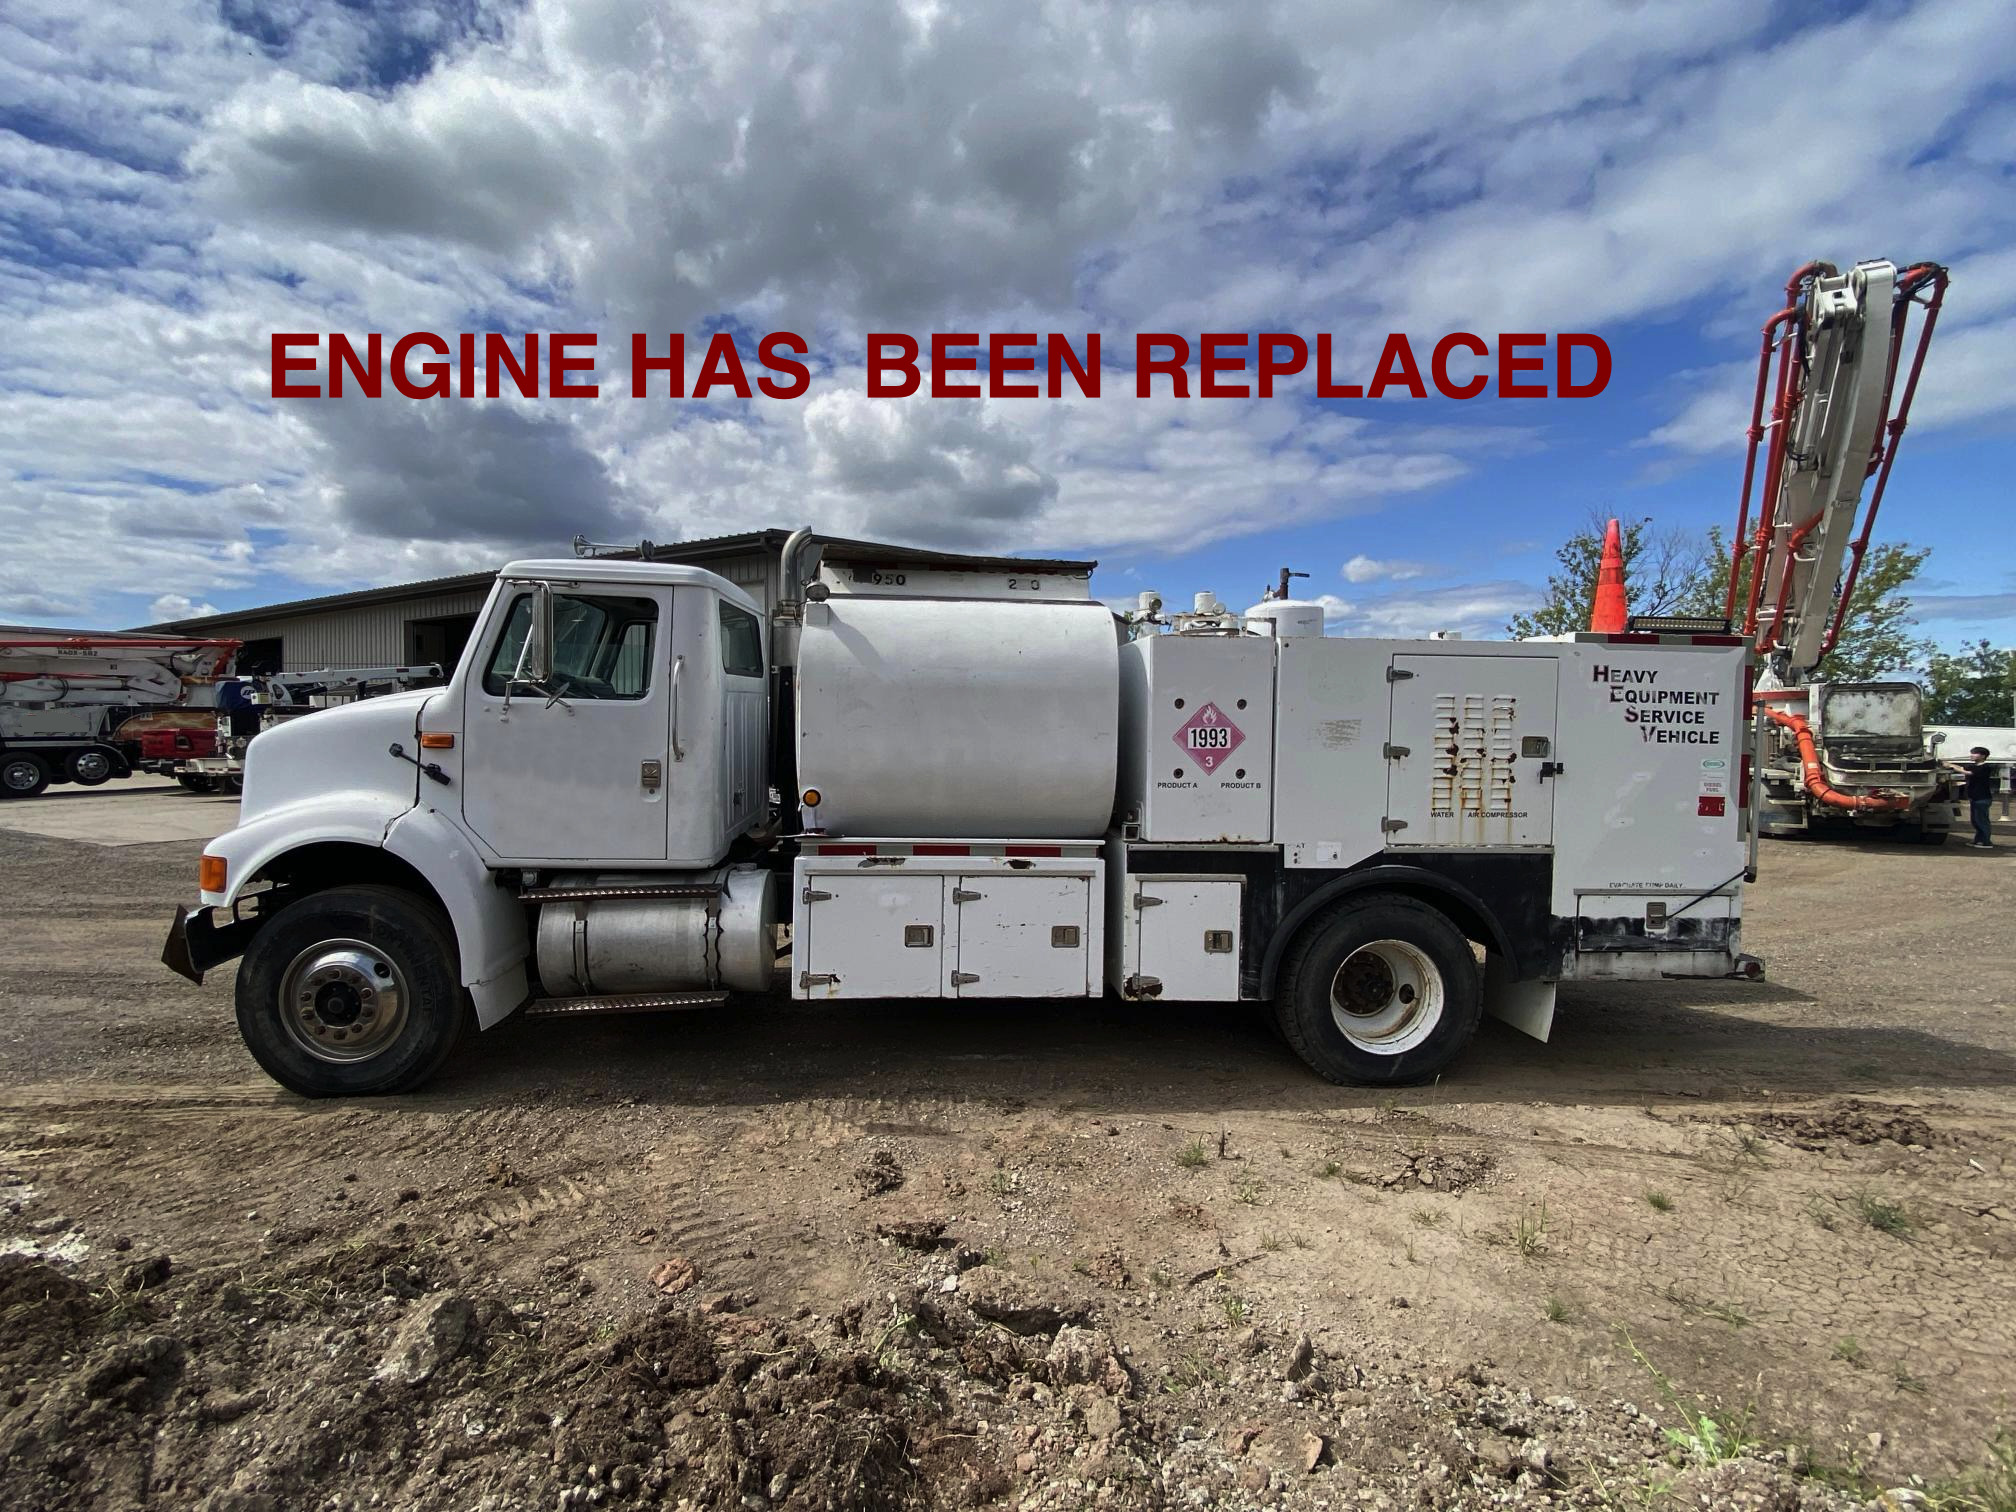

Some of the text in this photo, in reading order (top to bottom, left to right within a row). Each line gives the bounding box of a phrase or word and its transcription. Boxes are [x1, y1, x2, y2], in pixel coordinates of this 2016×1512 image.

[1592, 664, 1658, 684] HEAVY
[1610, 685, 1720, 705] EQUIPMENT
[1624, 705, 1705, 724] SERVICE
[1190, 728, 1228, 748] 1993
[1640, 725, 1720, 744] VEHICLE
[1205, 756, 1213, 768] 3
